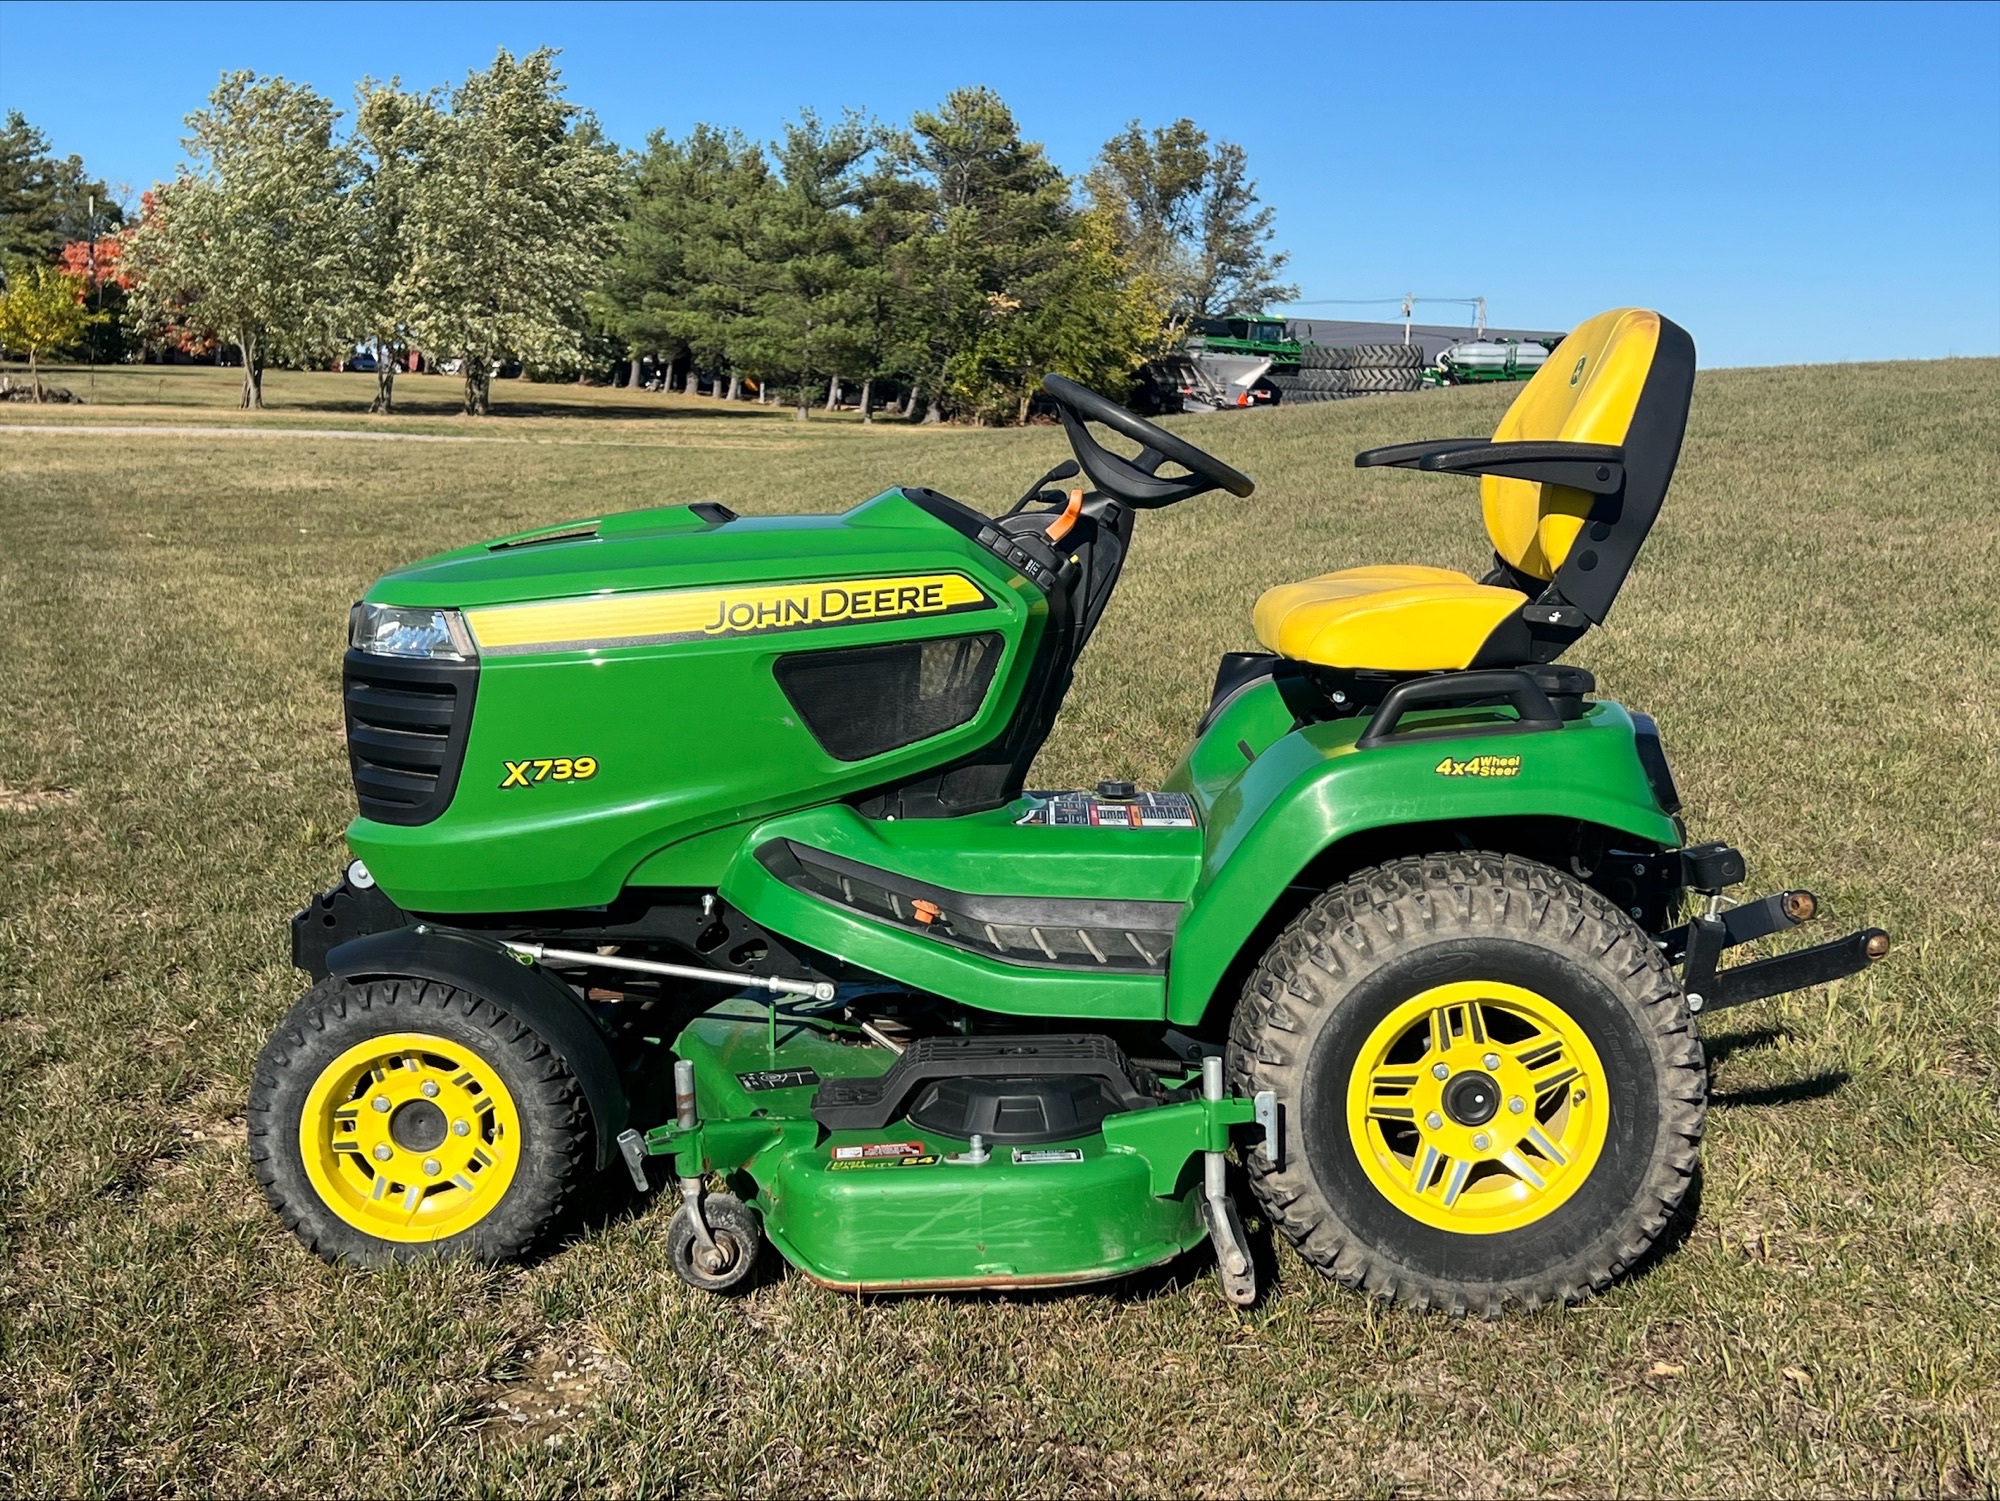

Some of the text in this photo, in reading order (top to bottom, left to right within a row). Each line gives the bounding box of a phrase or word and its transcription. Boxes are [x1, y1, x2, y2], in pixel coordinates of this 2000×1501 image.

[705, 583, 944, 632] JOHN DEERE
[499, 756, 598, 787] X739
[1435, 755, 1521, 775] 4x4 Wheel
[1480, 766, 1519, 777] Steer
[902, 1156, 935, 1165] 54
